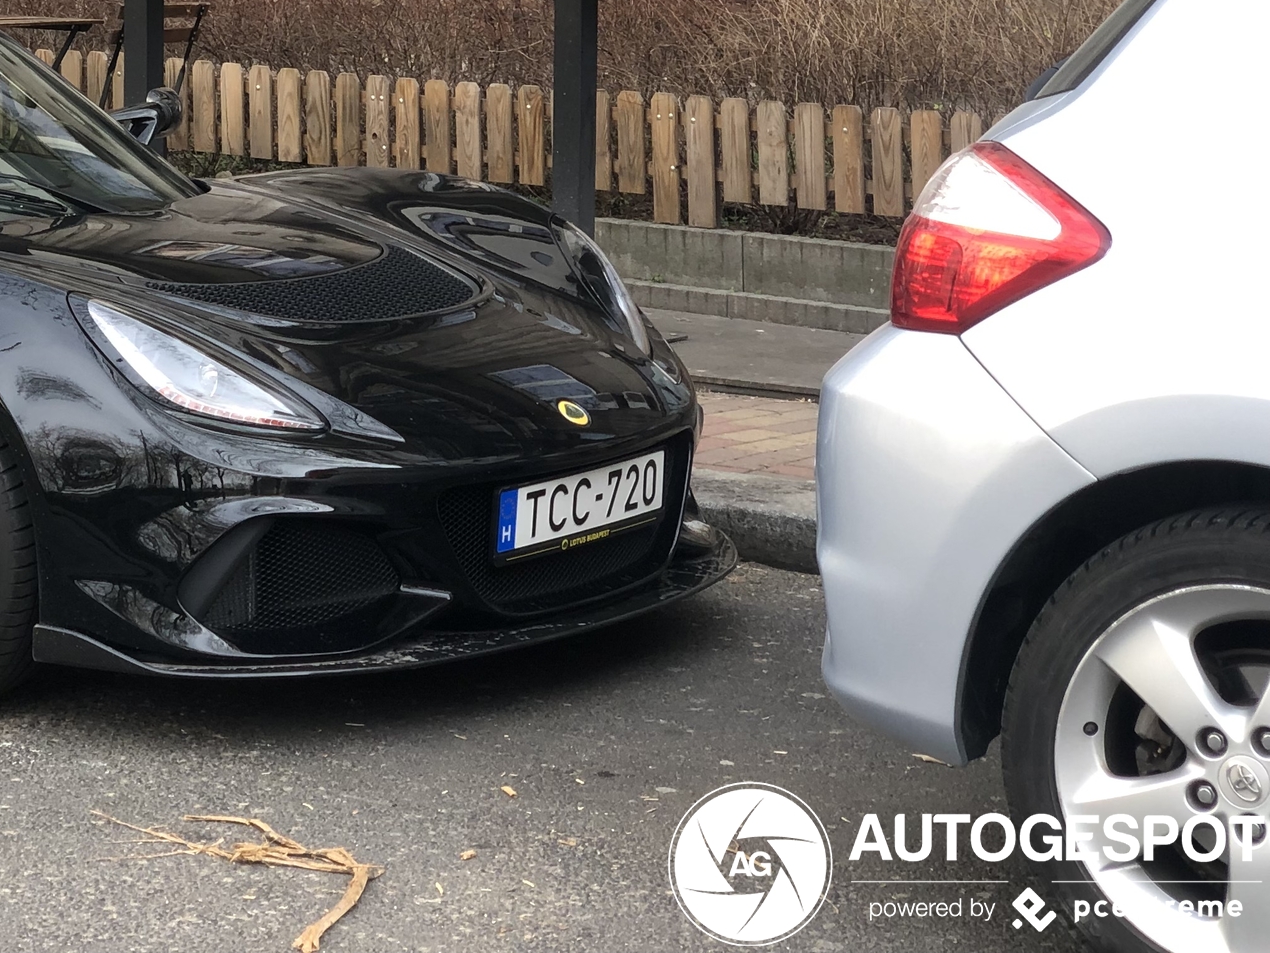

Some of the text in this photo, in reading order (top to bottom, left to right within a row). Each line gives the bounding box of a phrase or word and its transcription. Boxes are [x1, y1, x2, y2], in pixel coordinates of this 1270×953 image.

[526, 458, 658, 539] TCC-720
[501, 524, 512, 544] H
[570, 529, 611, 547] LOTUS BUDAPEST
